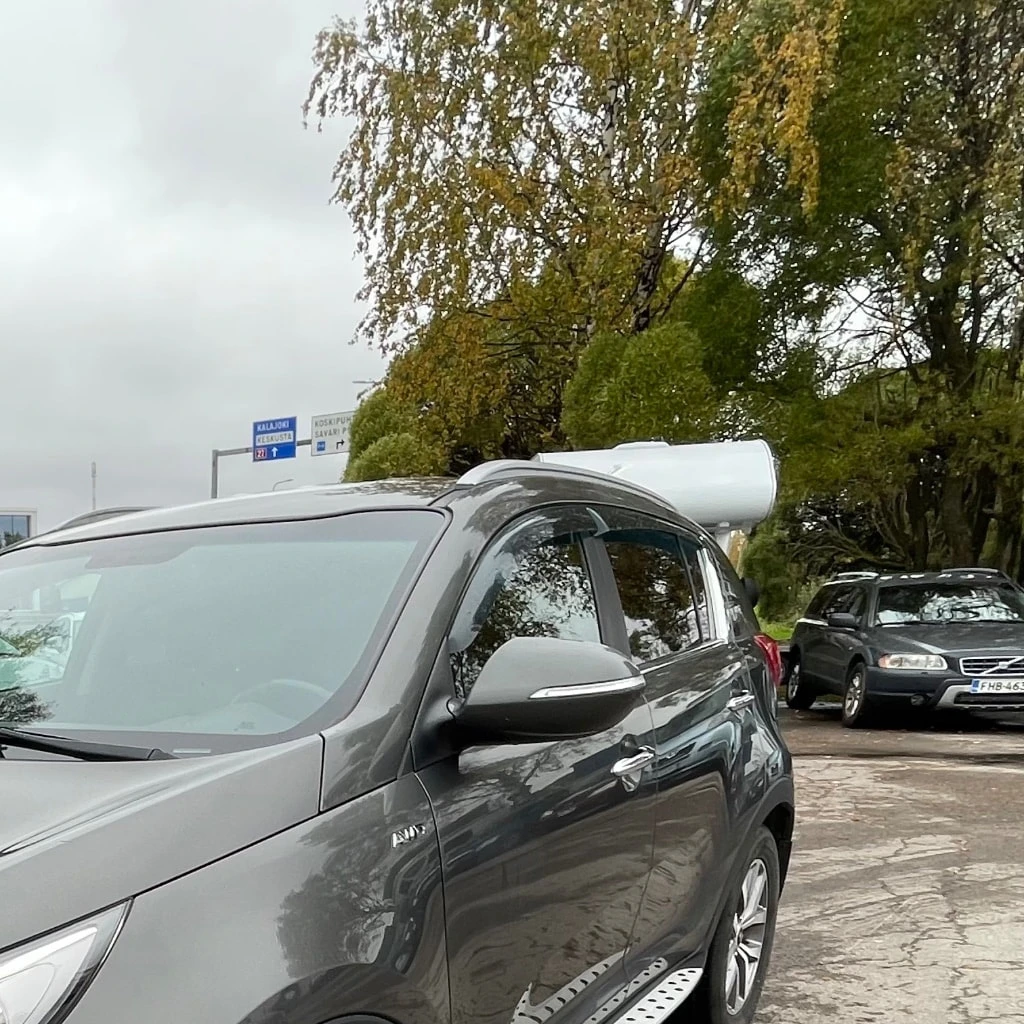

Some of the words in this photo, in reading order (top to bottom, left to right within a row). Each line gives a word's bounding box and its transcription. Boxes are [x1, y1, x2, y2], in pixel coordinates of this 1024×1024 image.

[257, 420, 290, 432] KALAJOKI
[314, 416, 352, 428] KOSKIPUH
[257, 433, 292, 444] KESKUSTA
[979, 681, 1024, 692] FHB-463
